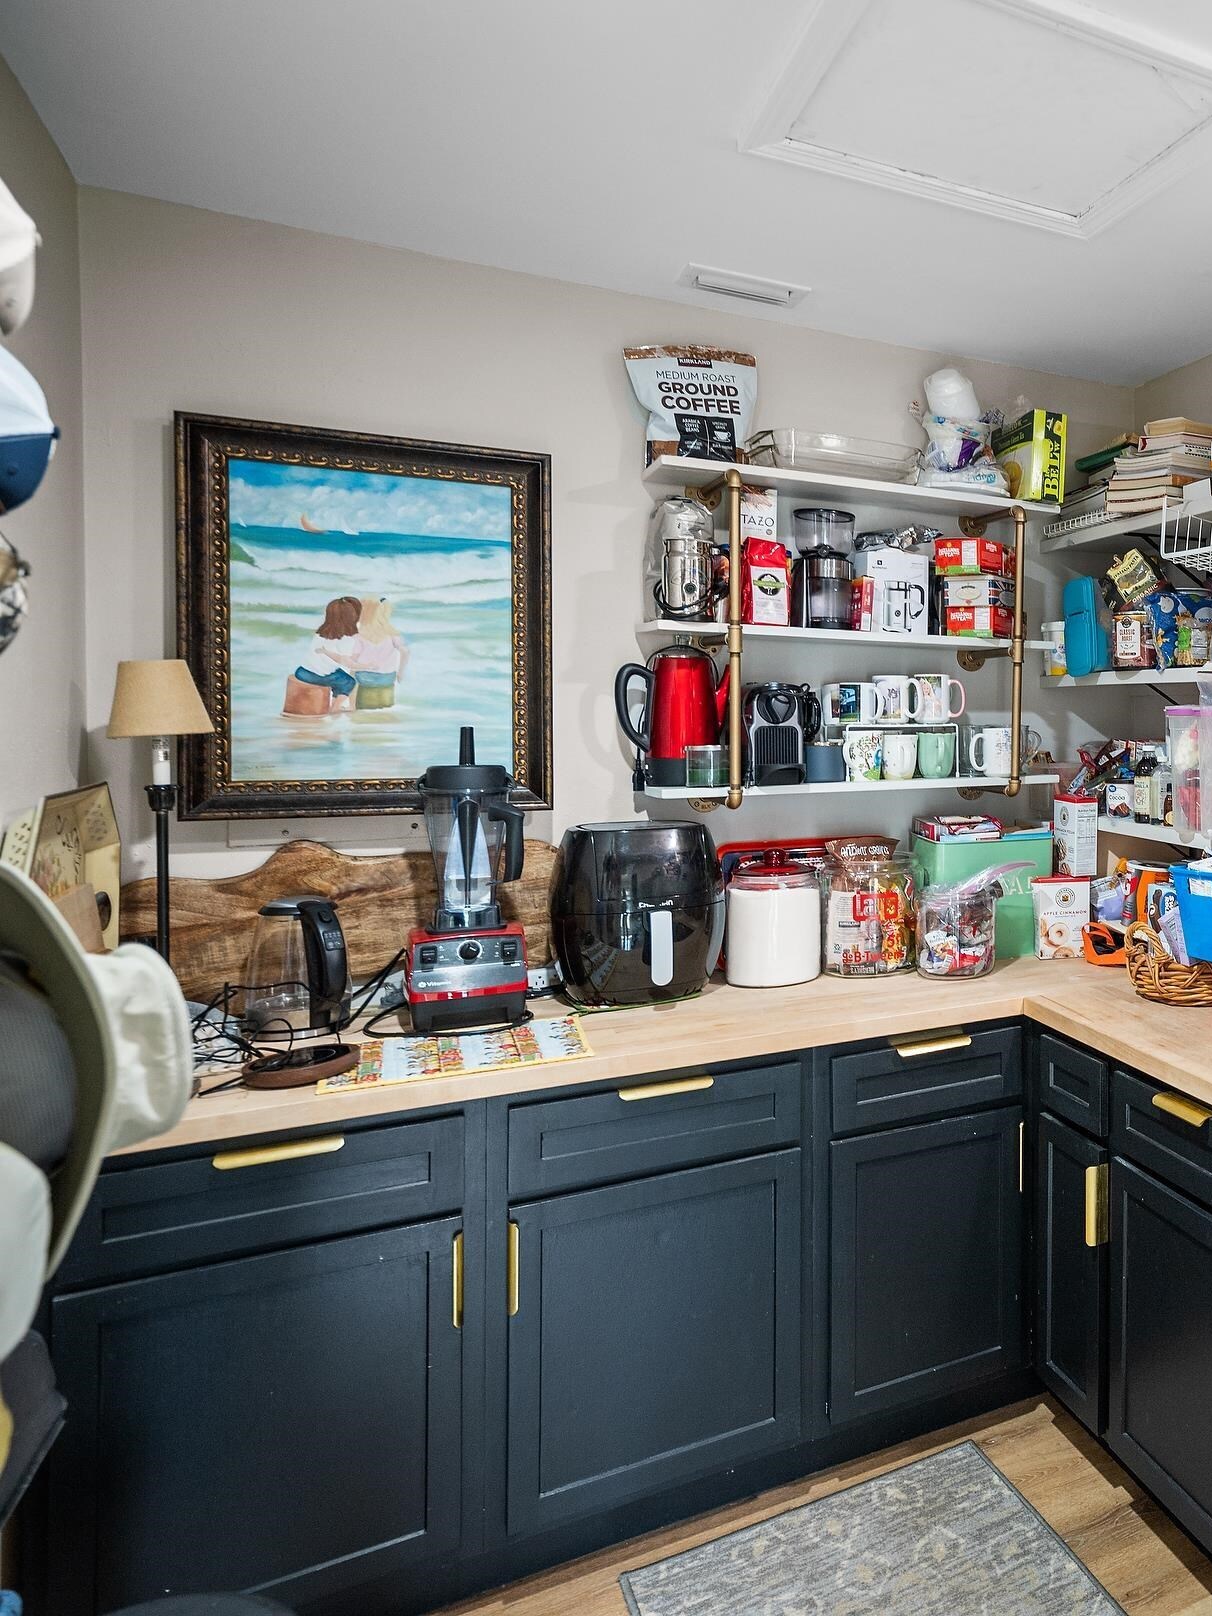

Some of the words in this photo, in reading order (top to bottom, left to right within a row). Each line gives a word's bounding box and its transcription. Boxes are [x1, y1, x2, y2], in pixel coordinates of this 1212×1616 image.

[656, 370, 699, 381] MEDIUM
[702, 373, 736, 384] ROAST
[658, 381, 739, 397] GROUND
[661, 395, 741, 416] COFFEE
[741, 513, 775, 528] TAZO
[1132, 583, 1159, 603] ORGANIC
[1109, 794, 1126, 802] Cocoa
